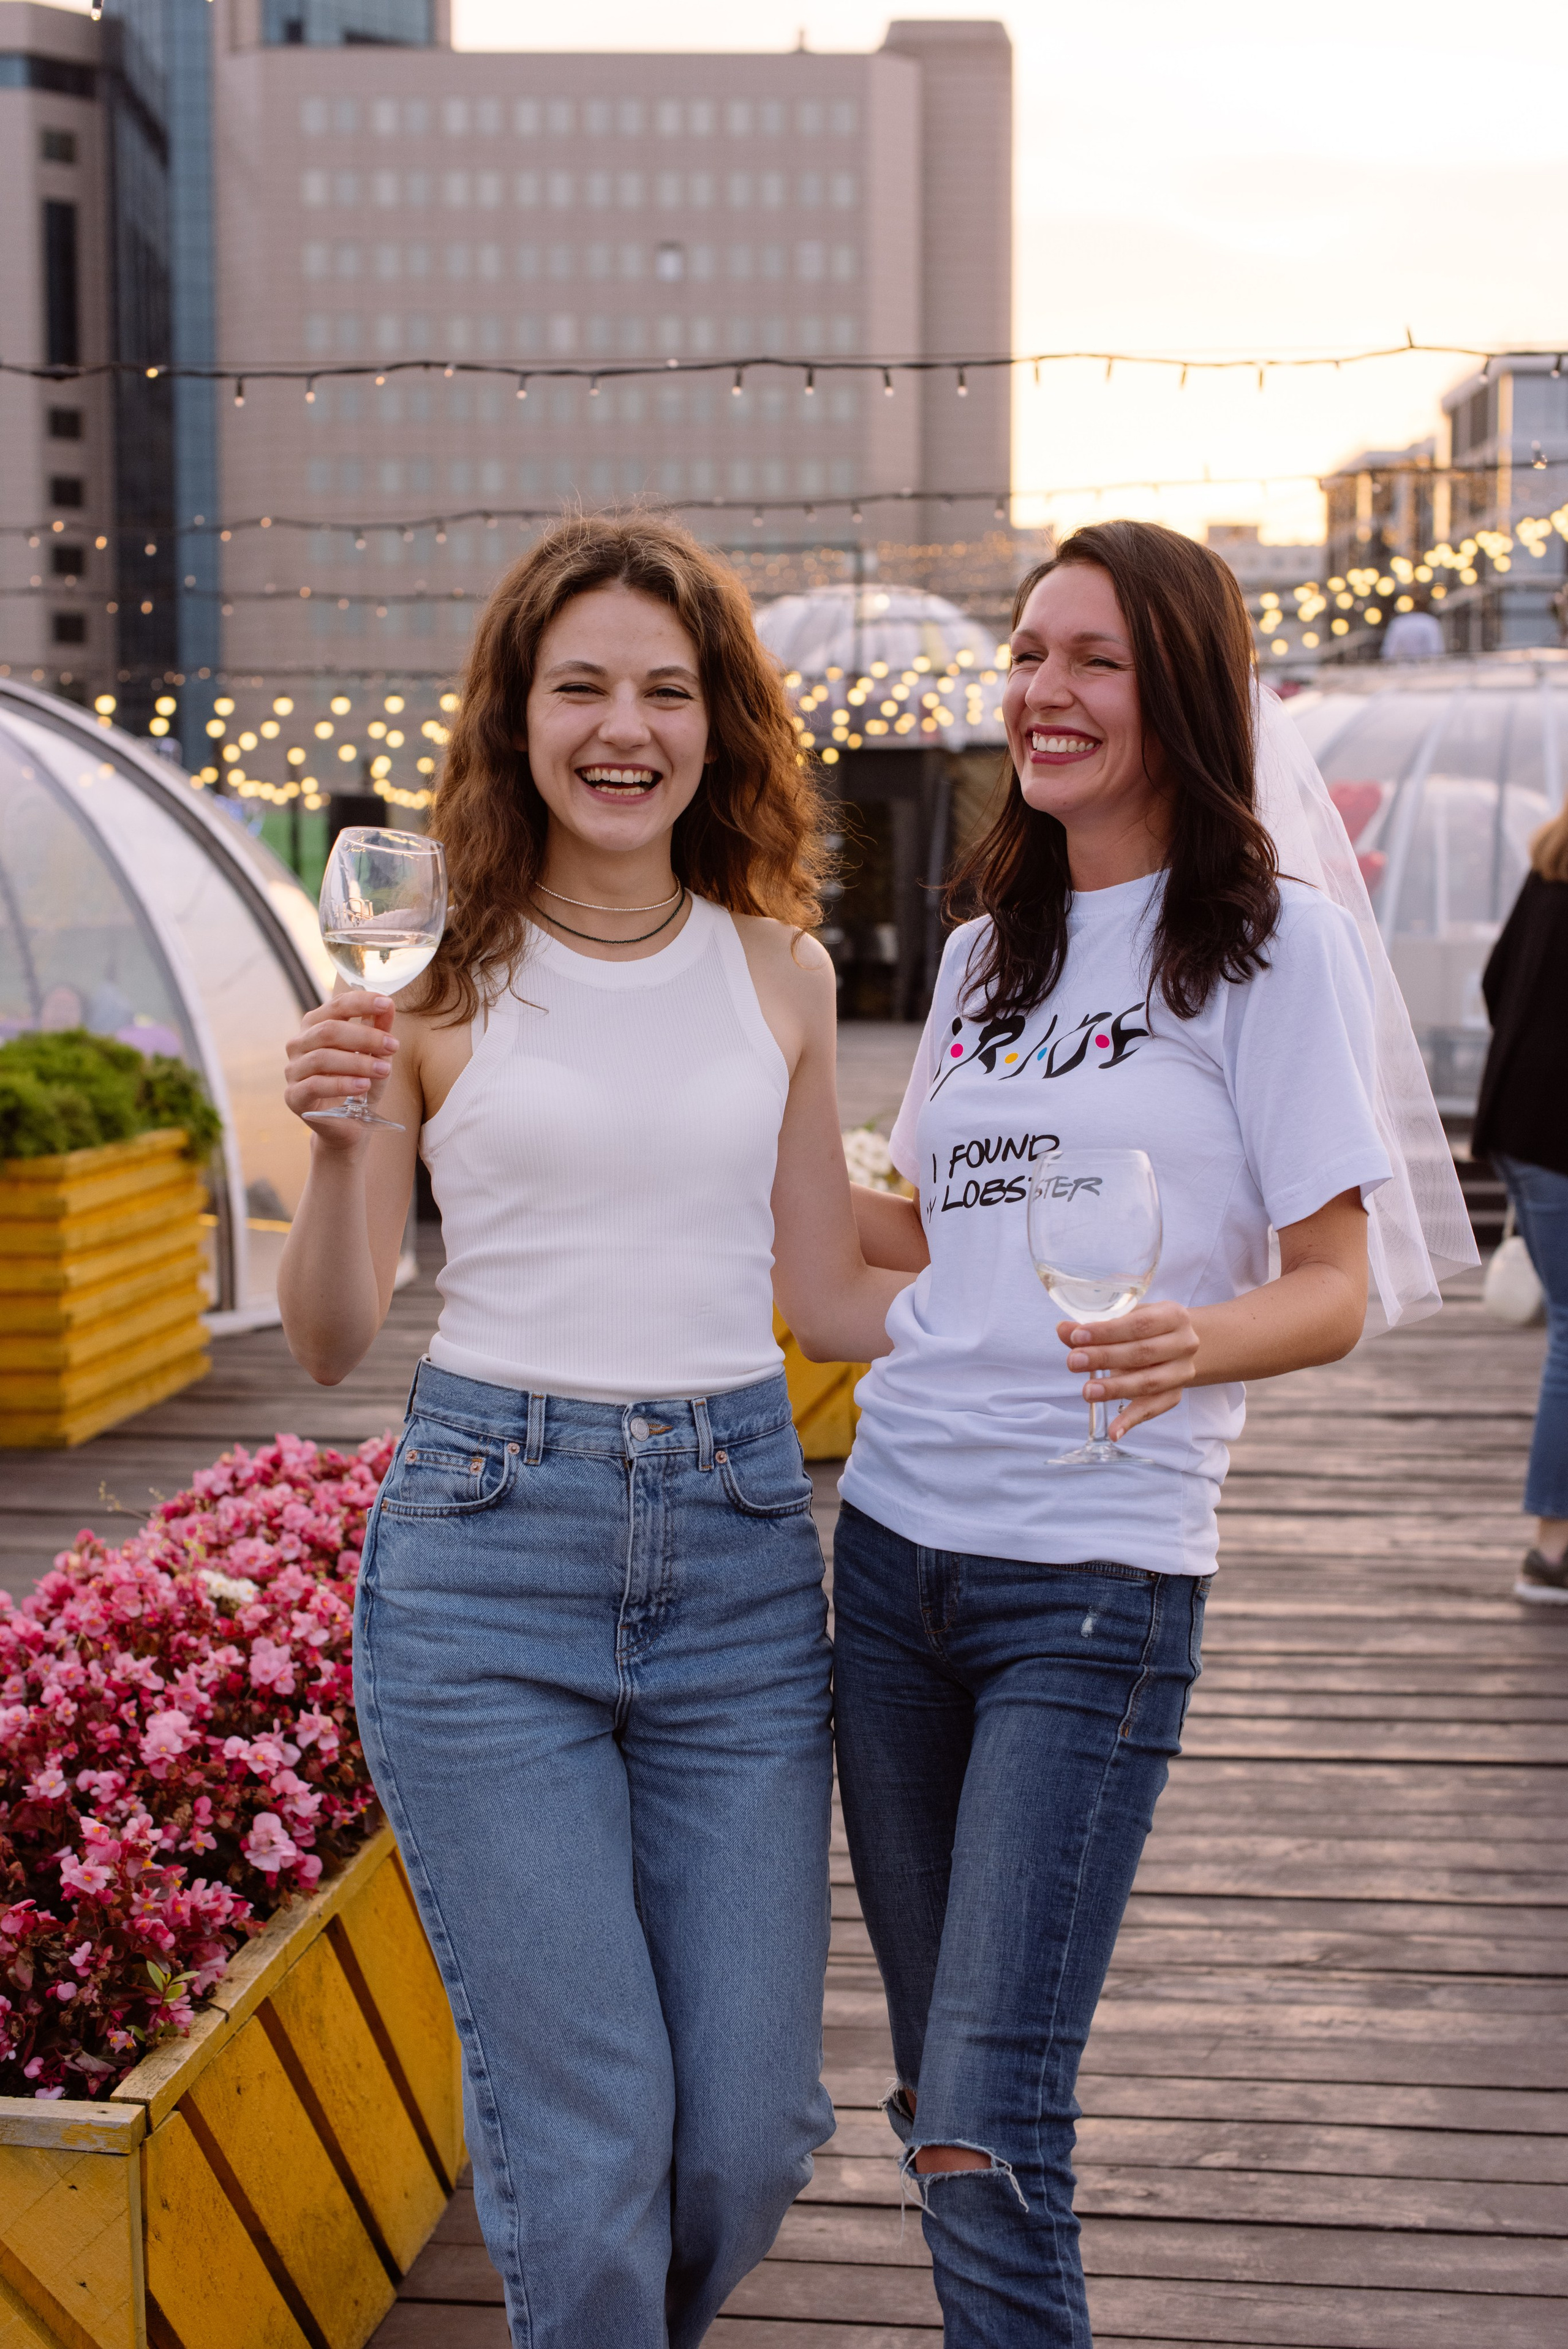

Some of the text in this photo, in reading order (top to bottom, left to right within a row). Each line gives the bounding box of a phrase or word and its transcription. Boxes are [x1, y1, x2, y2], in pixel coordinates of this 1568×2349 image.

[932, 1133, 1060, 1184] I FOUND
[941, 1175, 1103, 1212] LOBSTER
